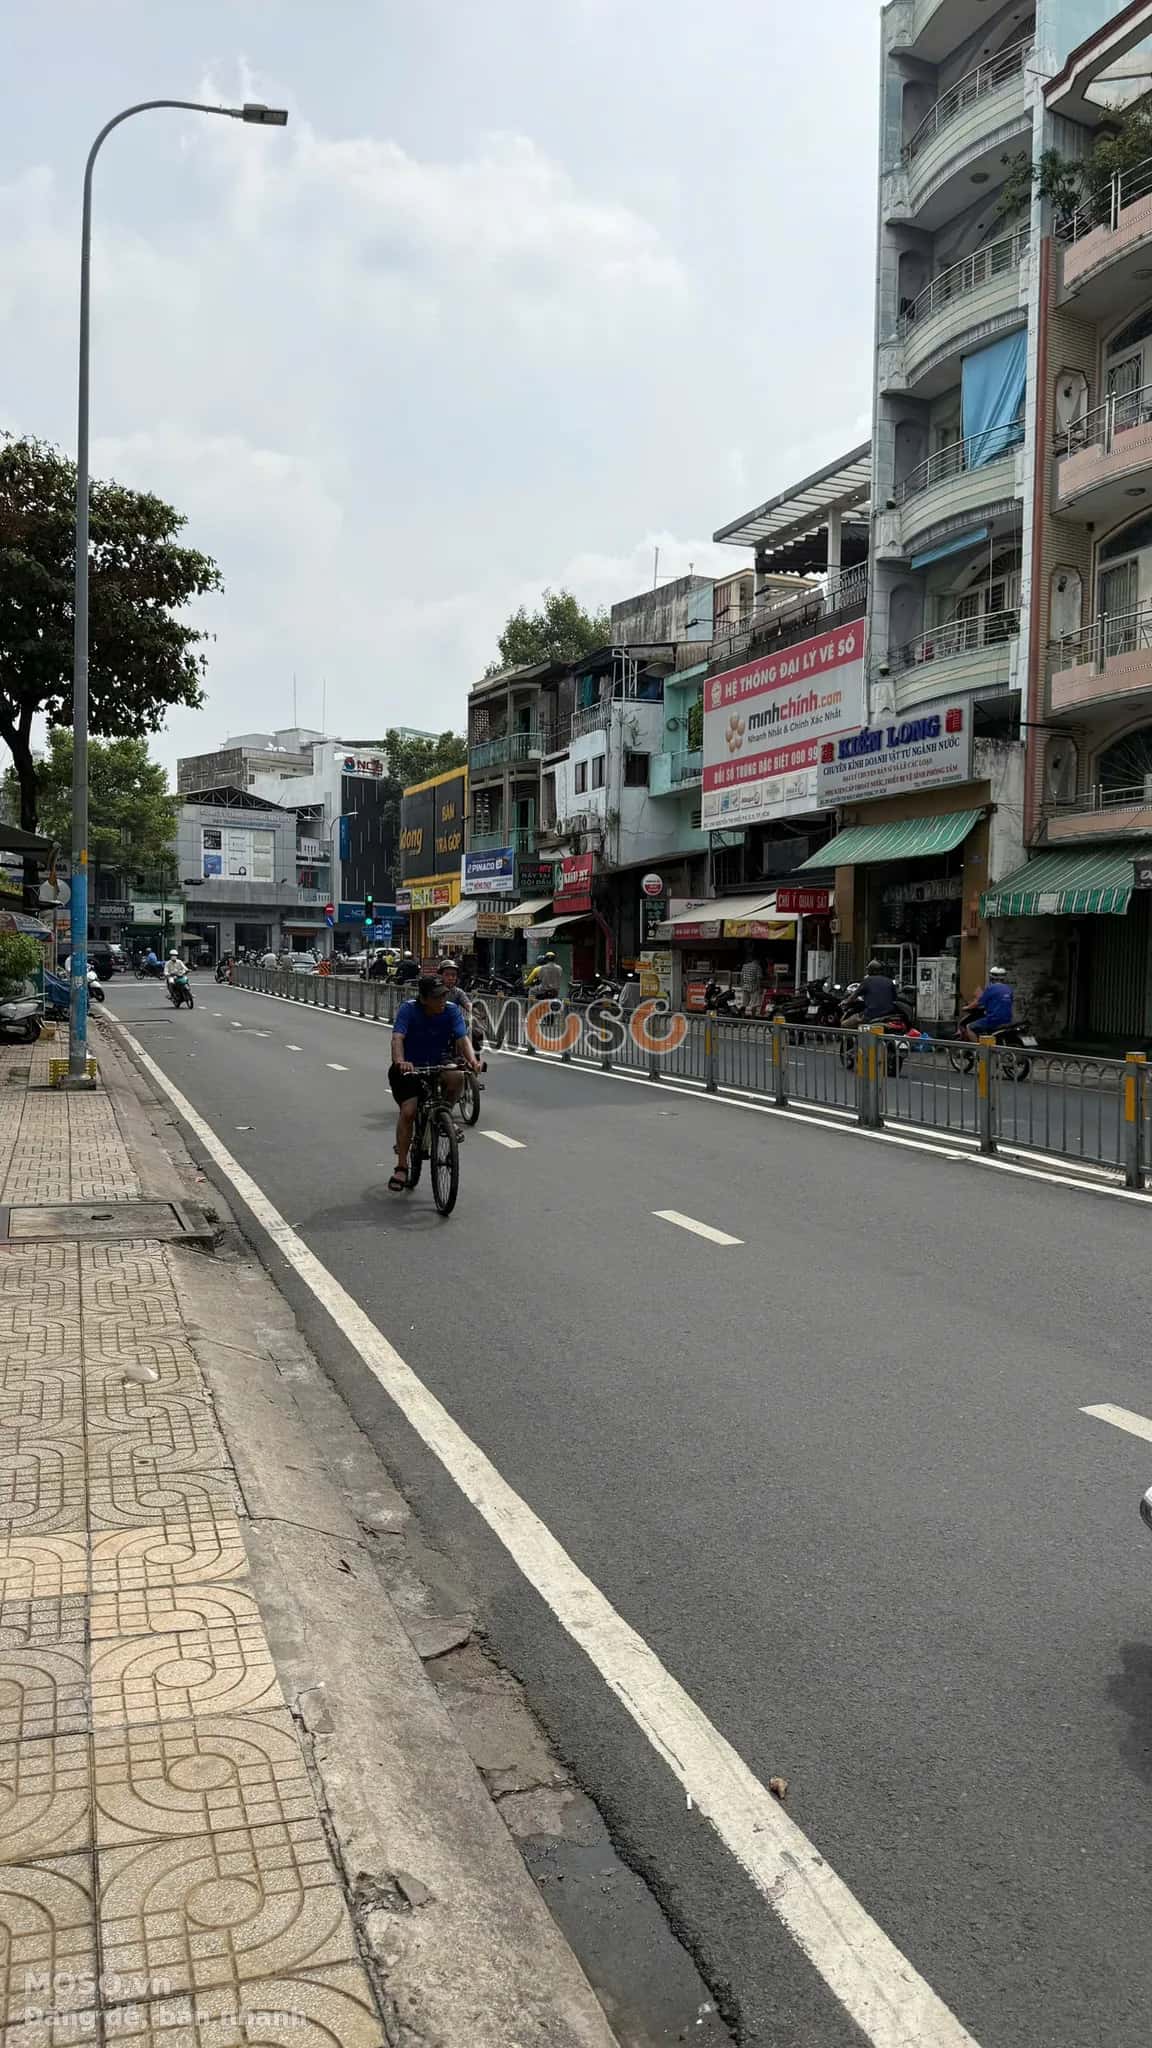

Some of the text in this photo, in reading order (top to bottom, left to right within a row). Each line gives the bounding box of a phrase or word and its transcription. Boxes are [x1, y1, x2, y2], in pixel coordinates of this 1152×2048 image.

[780, 656, 800, 679] ĐẠI
[803, 646, 817, 670] LÝ
[838, 629, 856, 657] SỐ
[824, 709, 842, 723] Nhất
[887, 715, 942, 748] LONG
[823, 758, 847, 776] CHUYÊN
[865, 753, 888, 769] DOANH
[912, 741, 938, 757] NGÀNH
